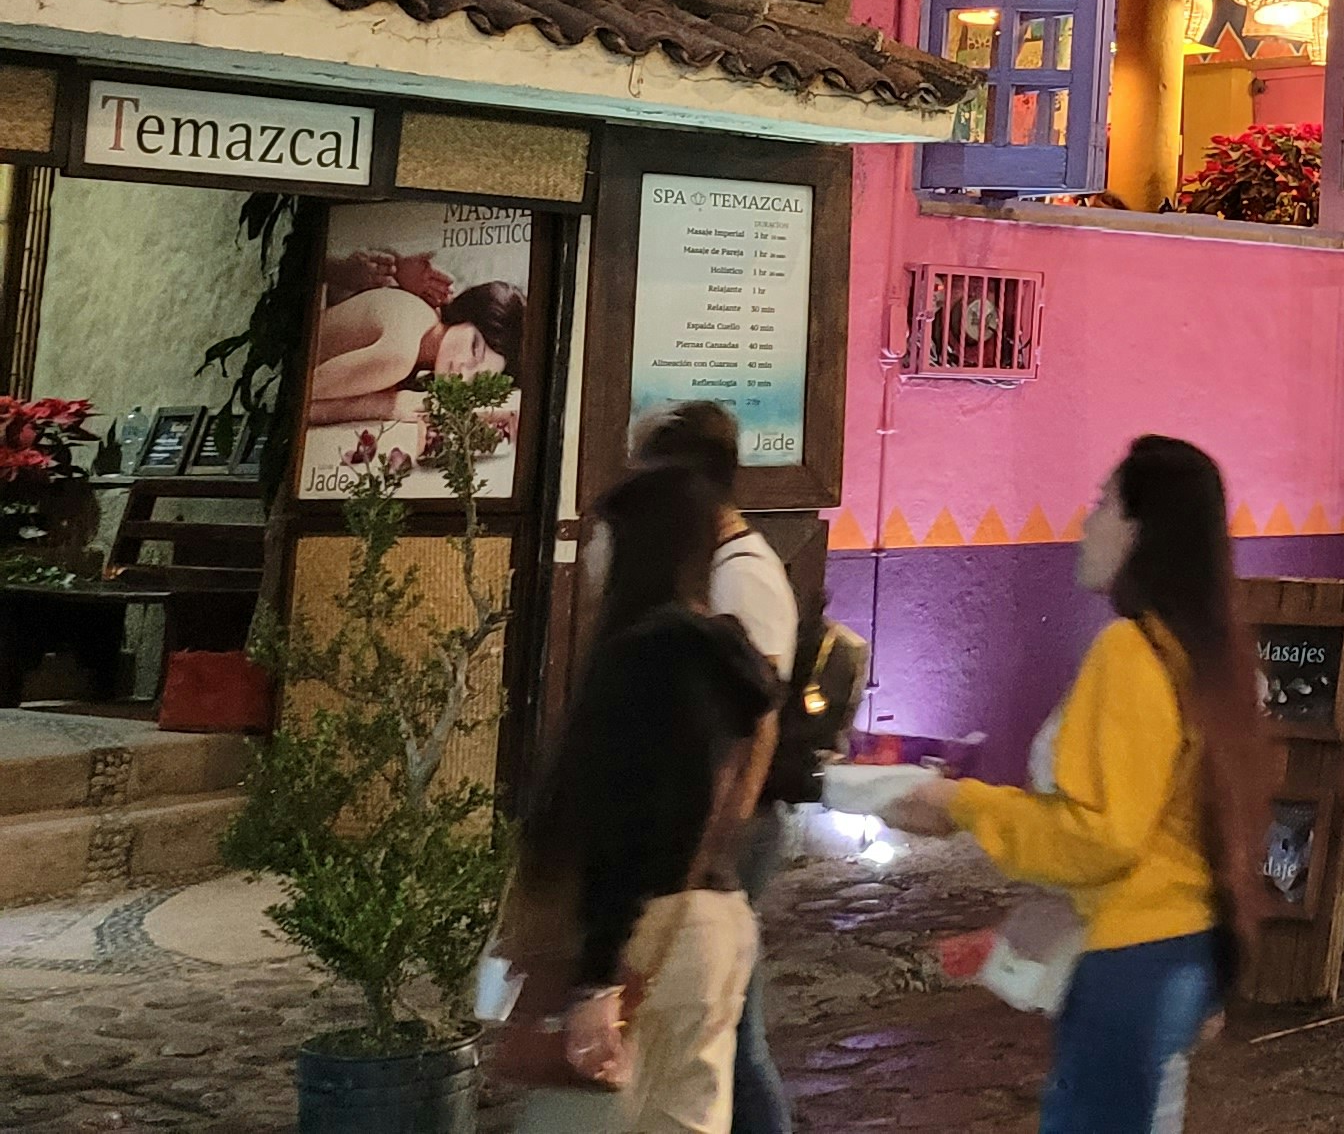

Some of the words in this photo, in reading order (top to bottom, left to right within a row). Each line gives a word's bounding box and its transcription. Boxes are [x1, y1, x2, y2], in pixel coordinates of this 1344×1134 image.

[101, 95, 360, 170] Temazcal
[653, 188, 687, 205] SPA
[709, 192, 804, 214] TEMAZCAL
[686, 227, 713, 237] Masaje
[683, 246, 709, 255] Masaje
[708, 285, 742, 294] Relajante
[707, 304, 741, 312] Relajante
[753, 433, 795, 451] Jade
[304, 466, 350, 492] Jade
[1257, 640, 1325, 667] Masajes
